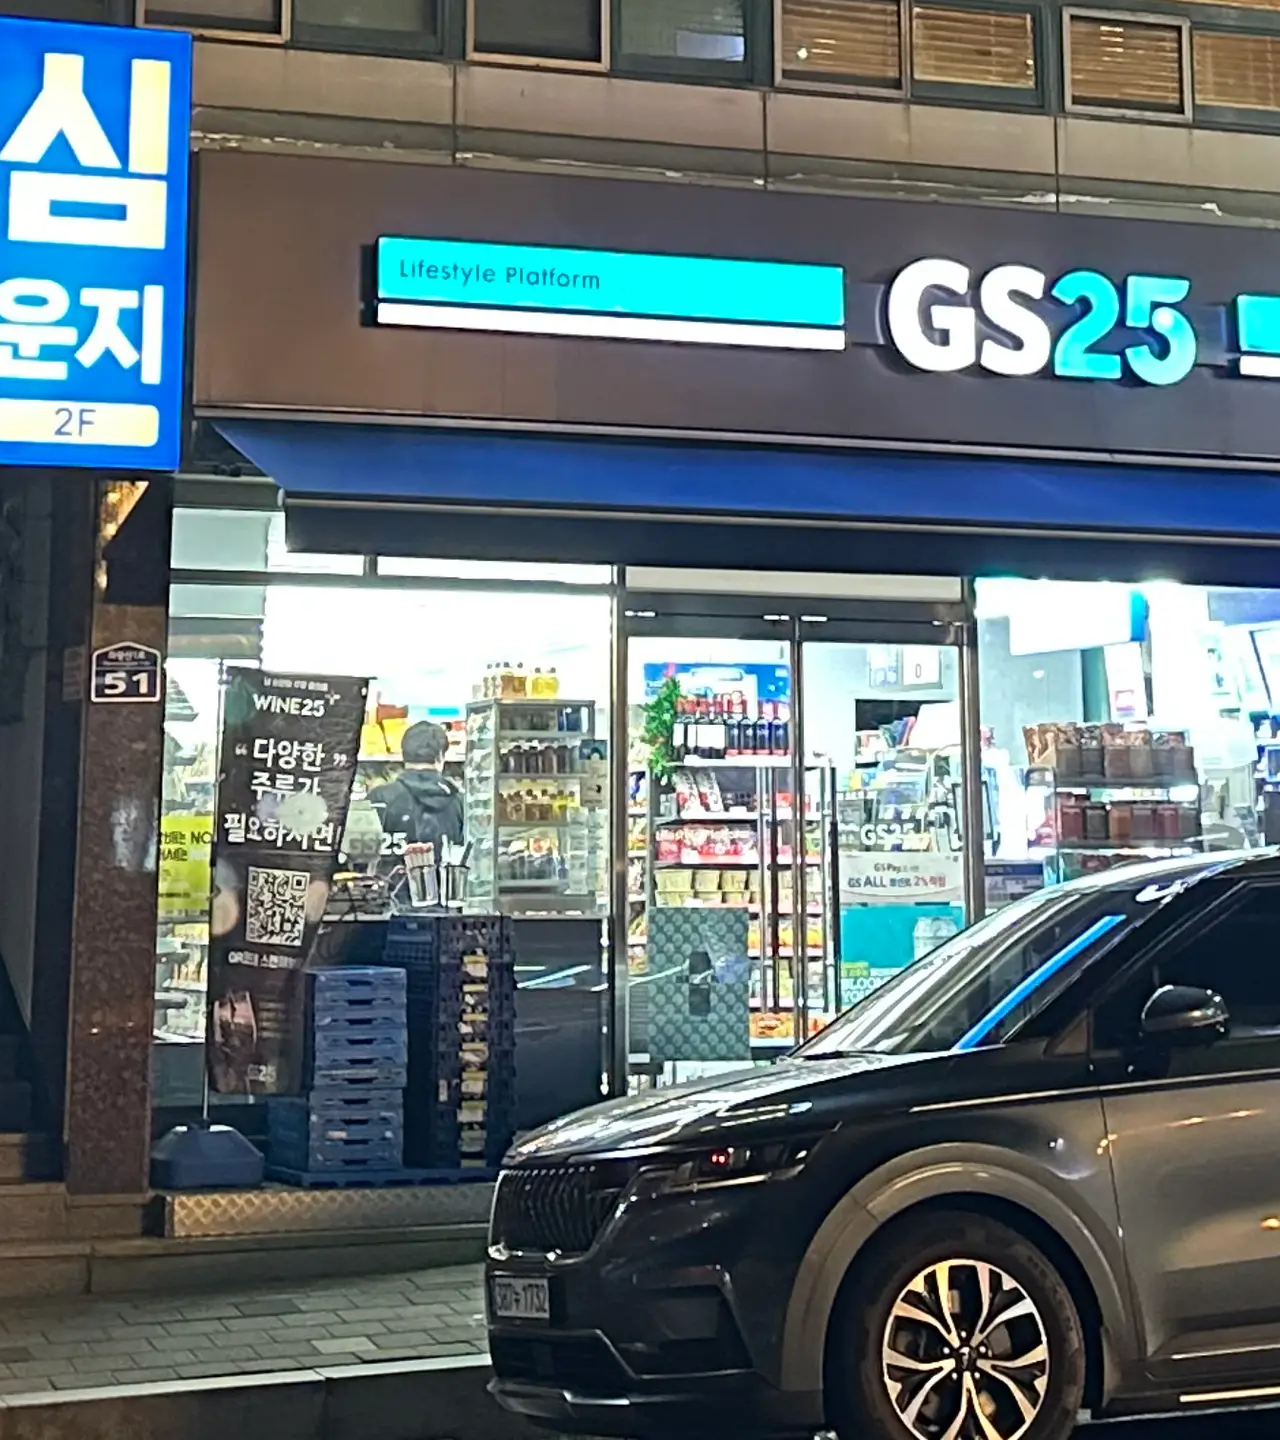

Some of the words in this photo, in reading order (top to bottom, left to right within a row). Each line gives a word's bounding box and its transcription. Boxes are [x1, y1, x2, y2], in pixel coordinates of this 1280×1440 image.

[400, 259, 496, 287] Lifestyle
[505, 267, 601, 290] Platform
[885, 256, 1202, 387] GS25
[53, 407, 97, 437] 2F
[104, 671, 149, 695] 51
[863, 875, 888, 889] ALL
